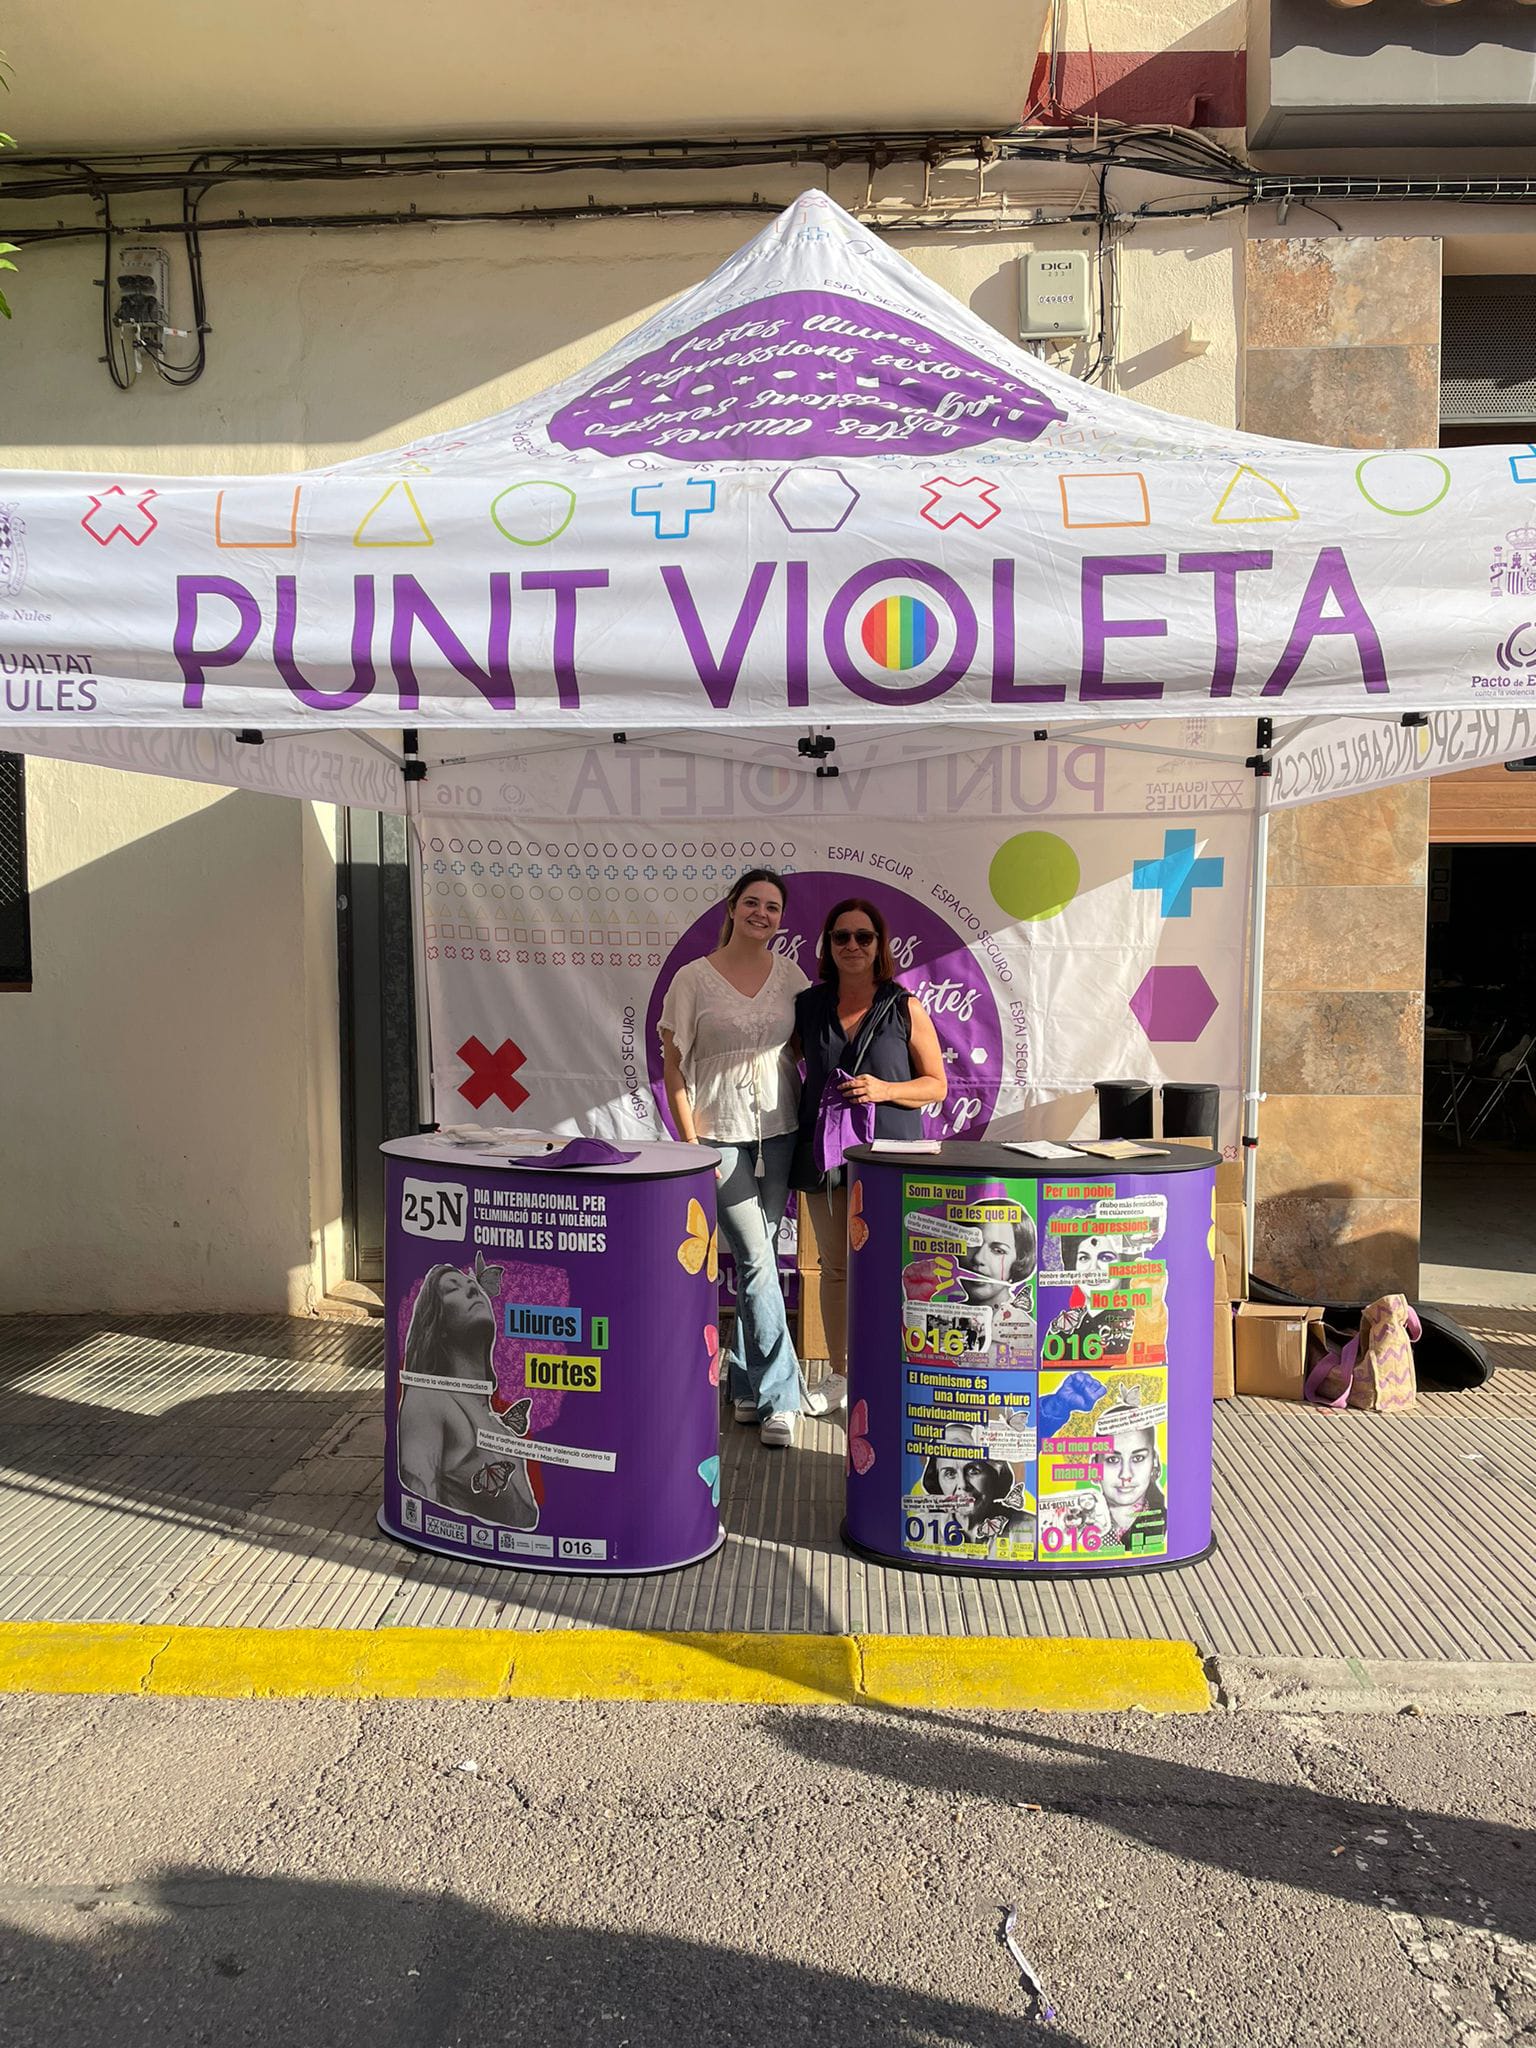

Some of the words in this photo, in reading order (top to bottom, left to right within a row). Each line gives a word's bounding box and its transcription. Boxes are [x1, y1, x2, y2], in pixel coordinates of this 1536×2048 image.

[1040, 262, 1072, 271] DIGI
[824, 279, 868, 298] ESPAI
[670, 318, 792, 363] festes
[802, 314, 937, 355] lliures
[13, 609, 52, 622] Nules
[173, 569, 609, 711] PUNT
[659, 546, 1391, 708] VIOLETA
[0, 653, 92, 675] UALTAT
[1471, 675, 1511, 688] Pacto
[1513, 678, 1524, 687] de
[6, 679, 98, 711] ULES
[828, 846, 865, 862] ESPAI
[869, 853, 914, 880] SEGUR
[930, 884, 981, 930] ESPACIO
[977, 930, 1013, 983] SEGURO
[1010, 1000, 1027, 1037] ESPAI
[622, 1006, 636, 1060] SEGURO
[1014, 1042, 1029, 1087] SEGUR
[623, 1065, 648, 1119] ESPACIO
[474, 1188, 490, 1205] DIA
[493, 1190, 579, 1211] INTERNACIONAL
[583, 1196, 606, 1212] PER
[908, 1185, 930, 1198] Som
[933, 1186, 942, 1198] la
[945, 1187, 964, 1199] veu
[1045, 1186, 1063, 1198] Per
[1066, 1186, 1080, 1198] un
[1083, 1185, 1114, 1199] poble
[404, 1191, 464, 1232] 25N
[474, 1207, 528, 1224] L'ELIMINACIÓ
[531, 1213, 542, 1225] DE
[545, 1213, 556, 1226] LA
[559, 1212, 607, 1228] VIOLÈNCIA
[950, 1207, 960, 1219] de
[966, 1208, 982, 1220] les
[985, 1209, 1005, 1221] que
[1007, 1208, 1018, 1220] ja
[1050, 1221, 1079, 1233] lliure
[1082, 1220, 1148, 1234] d'agressions
[474, 1225, 524, 1248] CONTRA
[529, 1230, 554, 1250] LES
[558, 1232, 607, 1253] DONES
[913, 1239, 927, 1252] no
[930, 1240, 966, 1255] estan.
[1109, 1263, 1162, 1276] masclistes
[1092, 1293, 1109, 1308] No
[1113, 1292, 1128, 1308] és
[1131, 1293, 1149, 1306] no.
[510, 1309, 576, 1337] Lliures
[597, 1321, 603, 1346] i
[905, 1326, 965, 1356] 016
[1043, 1333, 1104, 1360] 016
[413, 1377, 430, 1385] contra
[530, 1357, 597, 1387] fortes
[909, 1371, 918, 1383] El
[920, 1372, 973, 1388] feminisme
[974, 1376, 988, 1390] és
[934, 1390, 953, 1402] una
[955, 1391, 986, 1405] forma
[988, 1393, 1001, 1405] de
[1003, 1393, 1030, 1406] viure
[908, 1404, 981, 1423] individualment
[913, 1423, 944, 1438] lluitar
[480, 1432, 495, 1441] Nules
[534, 1444, 551, 1452] Pacte
[581, 1452, 603, 1460] contra
[604, 1453, 611, 1461] la
[505, 1446, 513, 1454] de
[541, 1454, 569, 1465] Masclista
[1043, 1440, 1053, 1452] És
[1057, 1440, 1066, 1452] el
[1068, 1442, 1089, 1452] meu
[1054, 1468, 1084, 1479] mane
[439, 1527, 465, 1541] NULES
[905, 1516, 964, 1546] 016
[1042, 1525, 1102, 1552] 016
[562, 1540, 593, 1555] 016
